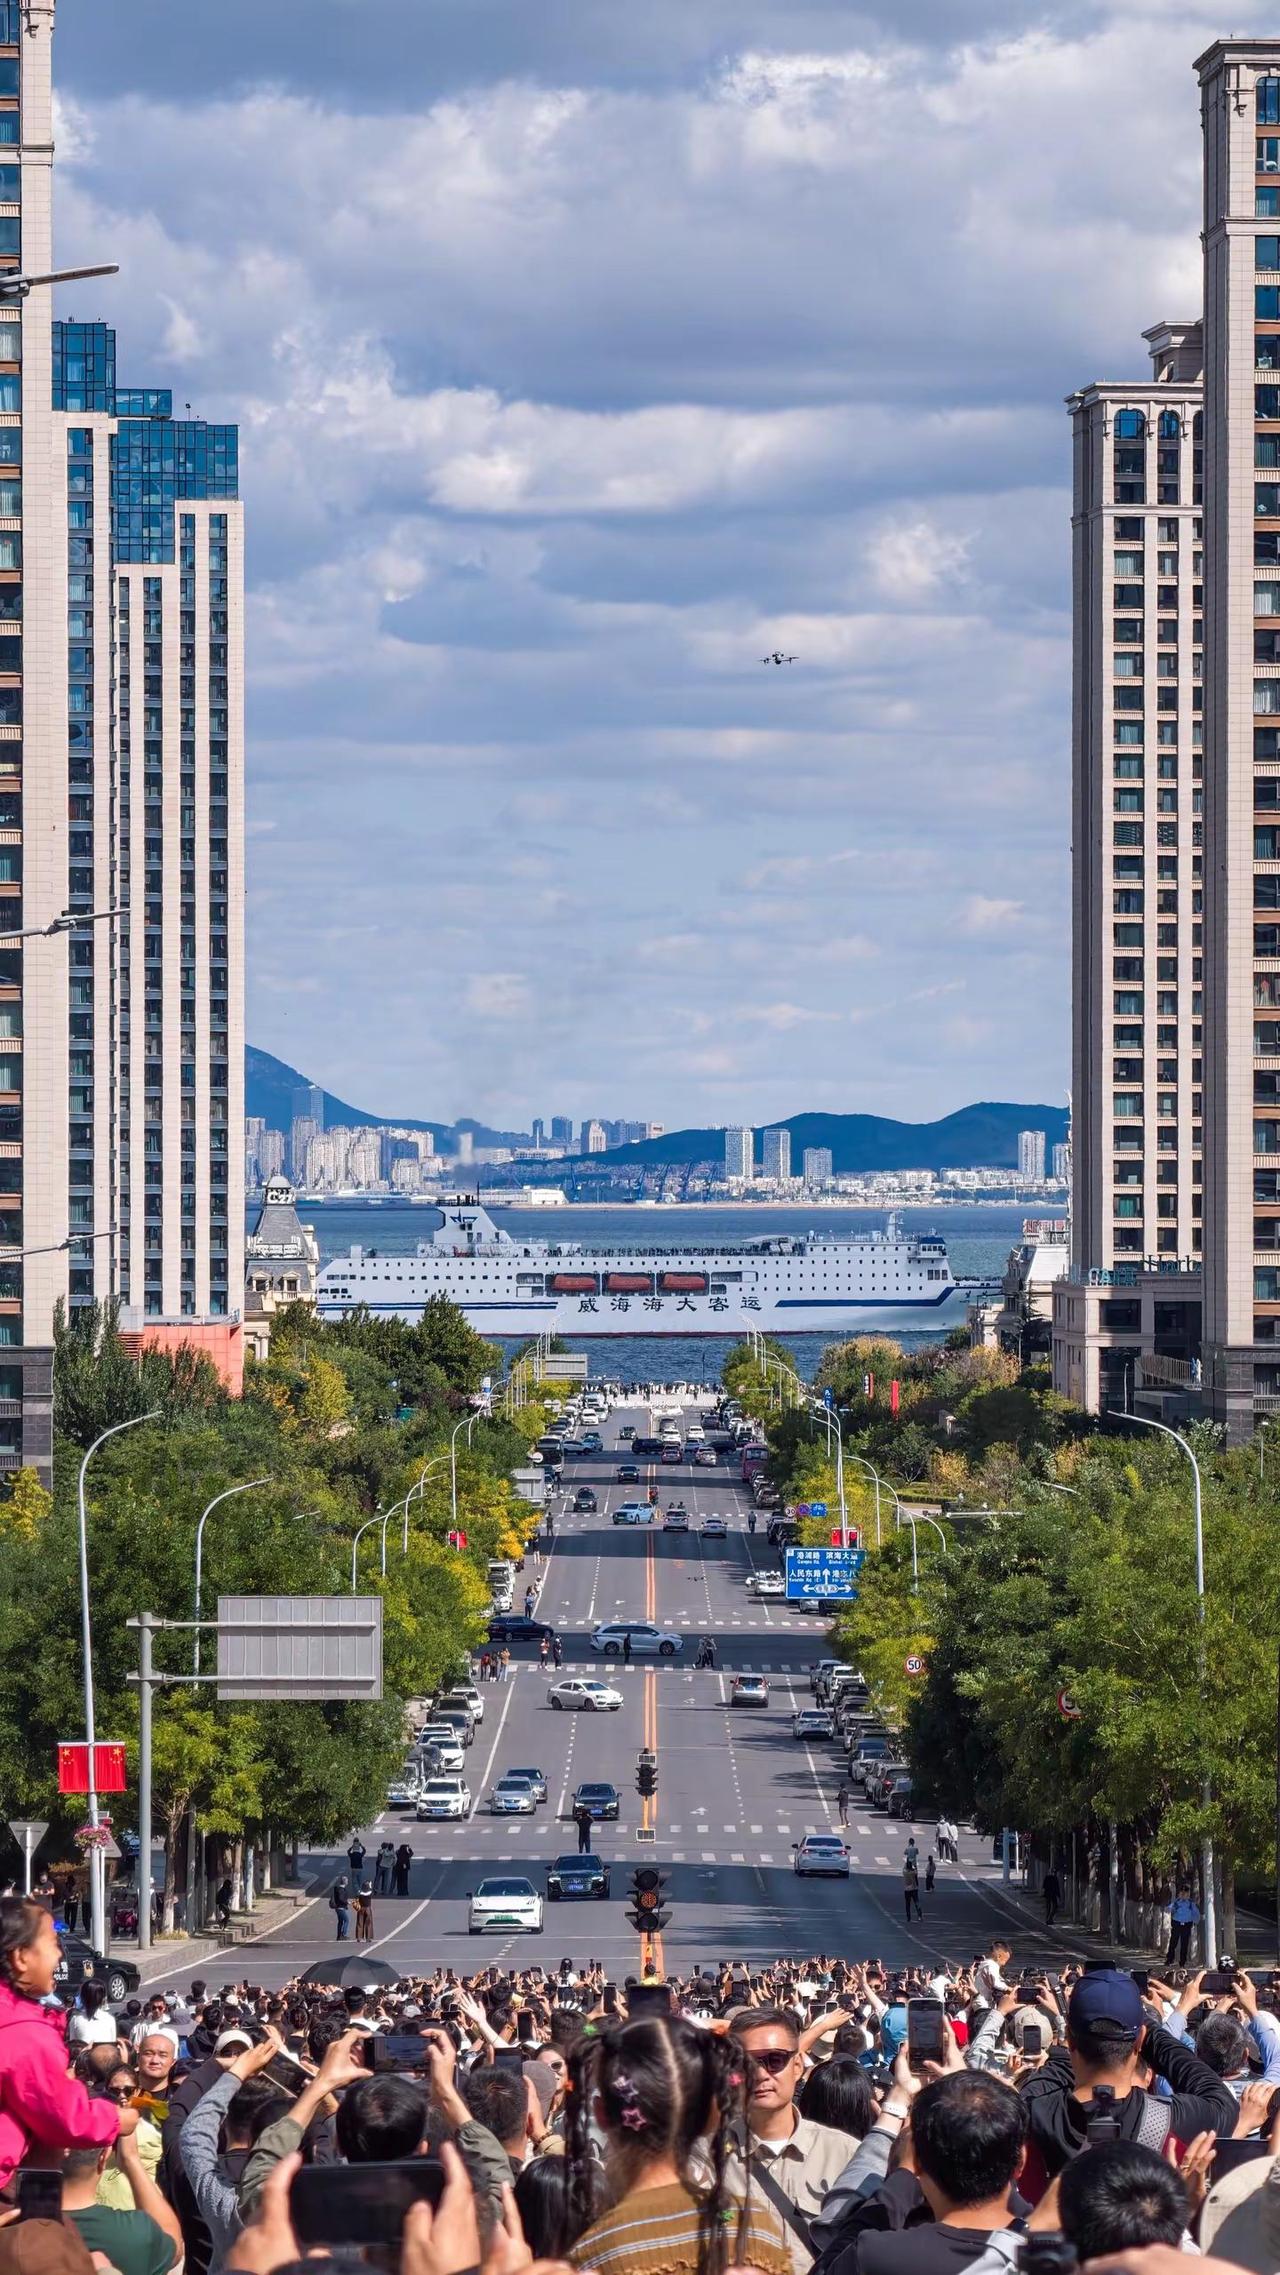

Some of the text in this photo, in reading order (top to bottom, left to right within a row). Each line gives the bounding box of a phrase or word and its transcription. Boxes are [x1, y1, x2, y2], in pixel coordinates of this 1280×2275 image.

[578, 1297, 762, 1312] 威海海大客运
[826, 1551, 858, 1560] 滨海大道
[789, 1569, 821, 1578] 人民东路
[908, 1660, 921, 1670] 50
